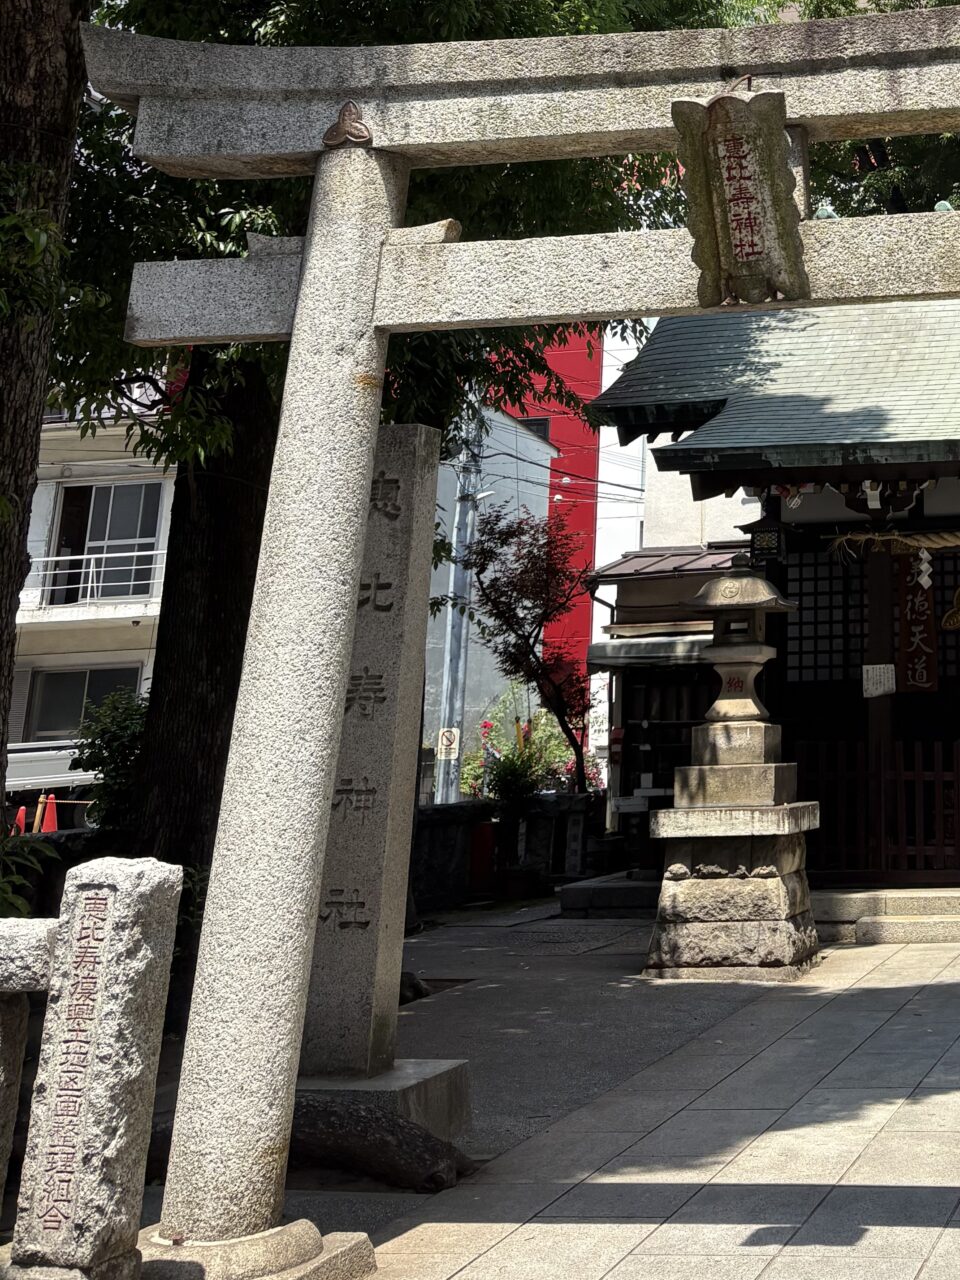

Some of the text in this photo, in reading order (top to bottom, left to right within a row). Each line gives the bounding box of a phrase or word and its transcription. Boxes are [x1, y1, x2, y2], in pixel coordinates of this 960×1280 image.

[37, 892, 107, 1231] 恵比寿復興土地区画整理組合
